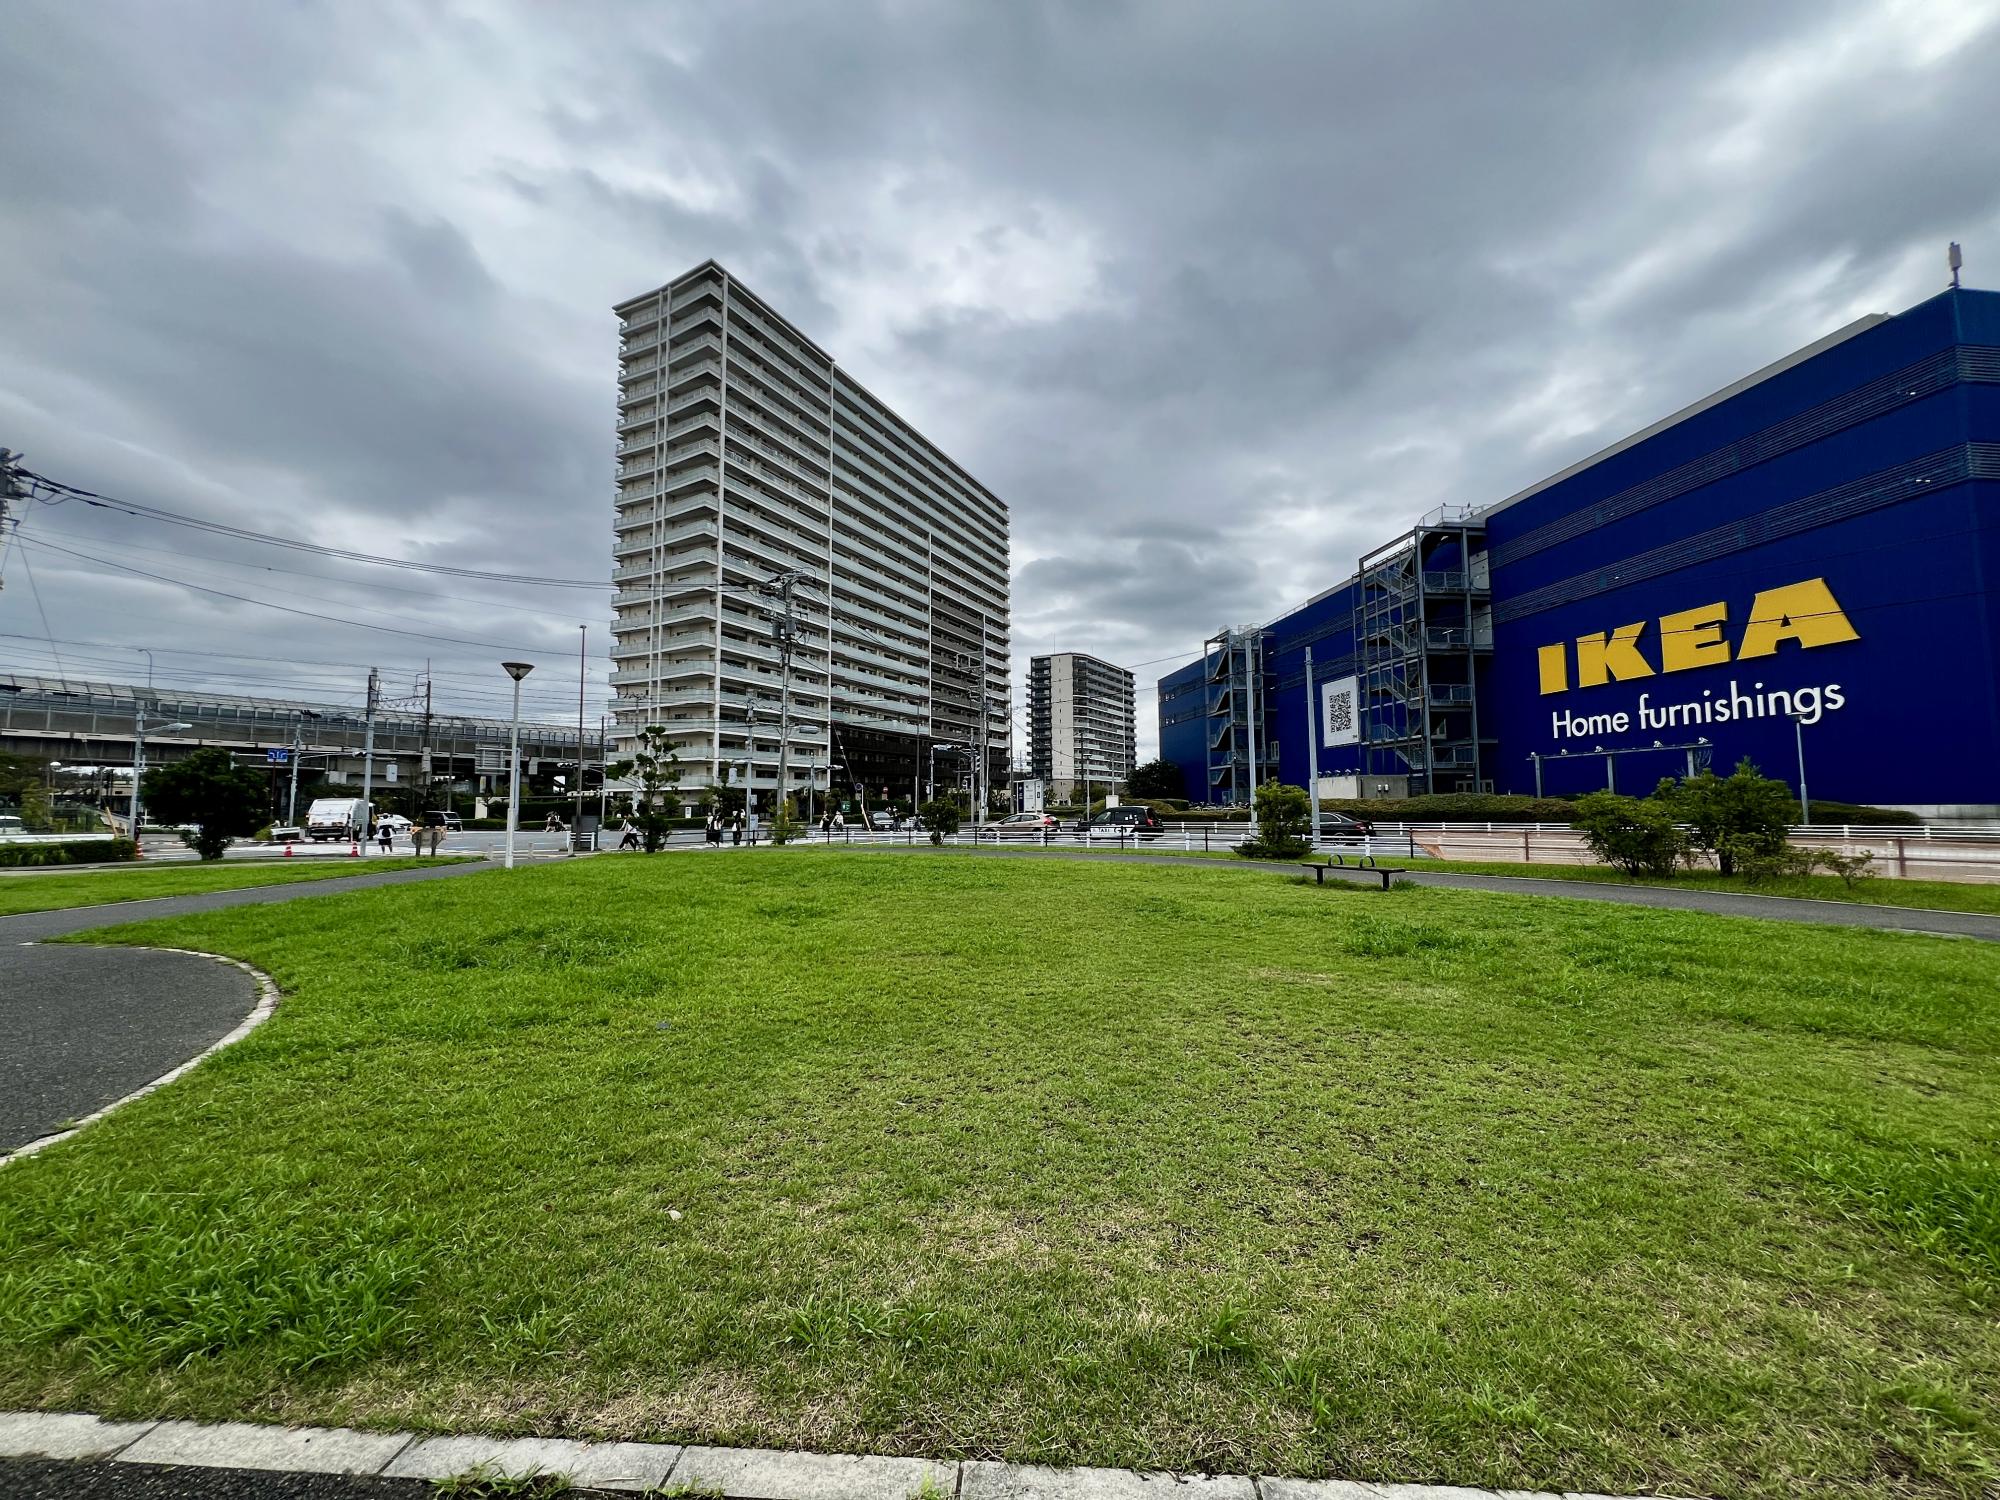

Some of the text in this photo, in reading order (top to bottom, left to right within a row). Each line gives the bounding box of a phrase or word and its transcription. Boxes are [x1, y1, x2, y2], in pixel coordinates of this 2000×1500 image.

[1538, 577, 1861, 695] IKEA
[1552, 680, 1846, 738] Home furnishings
